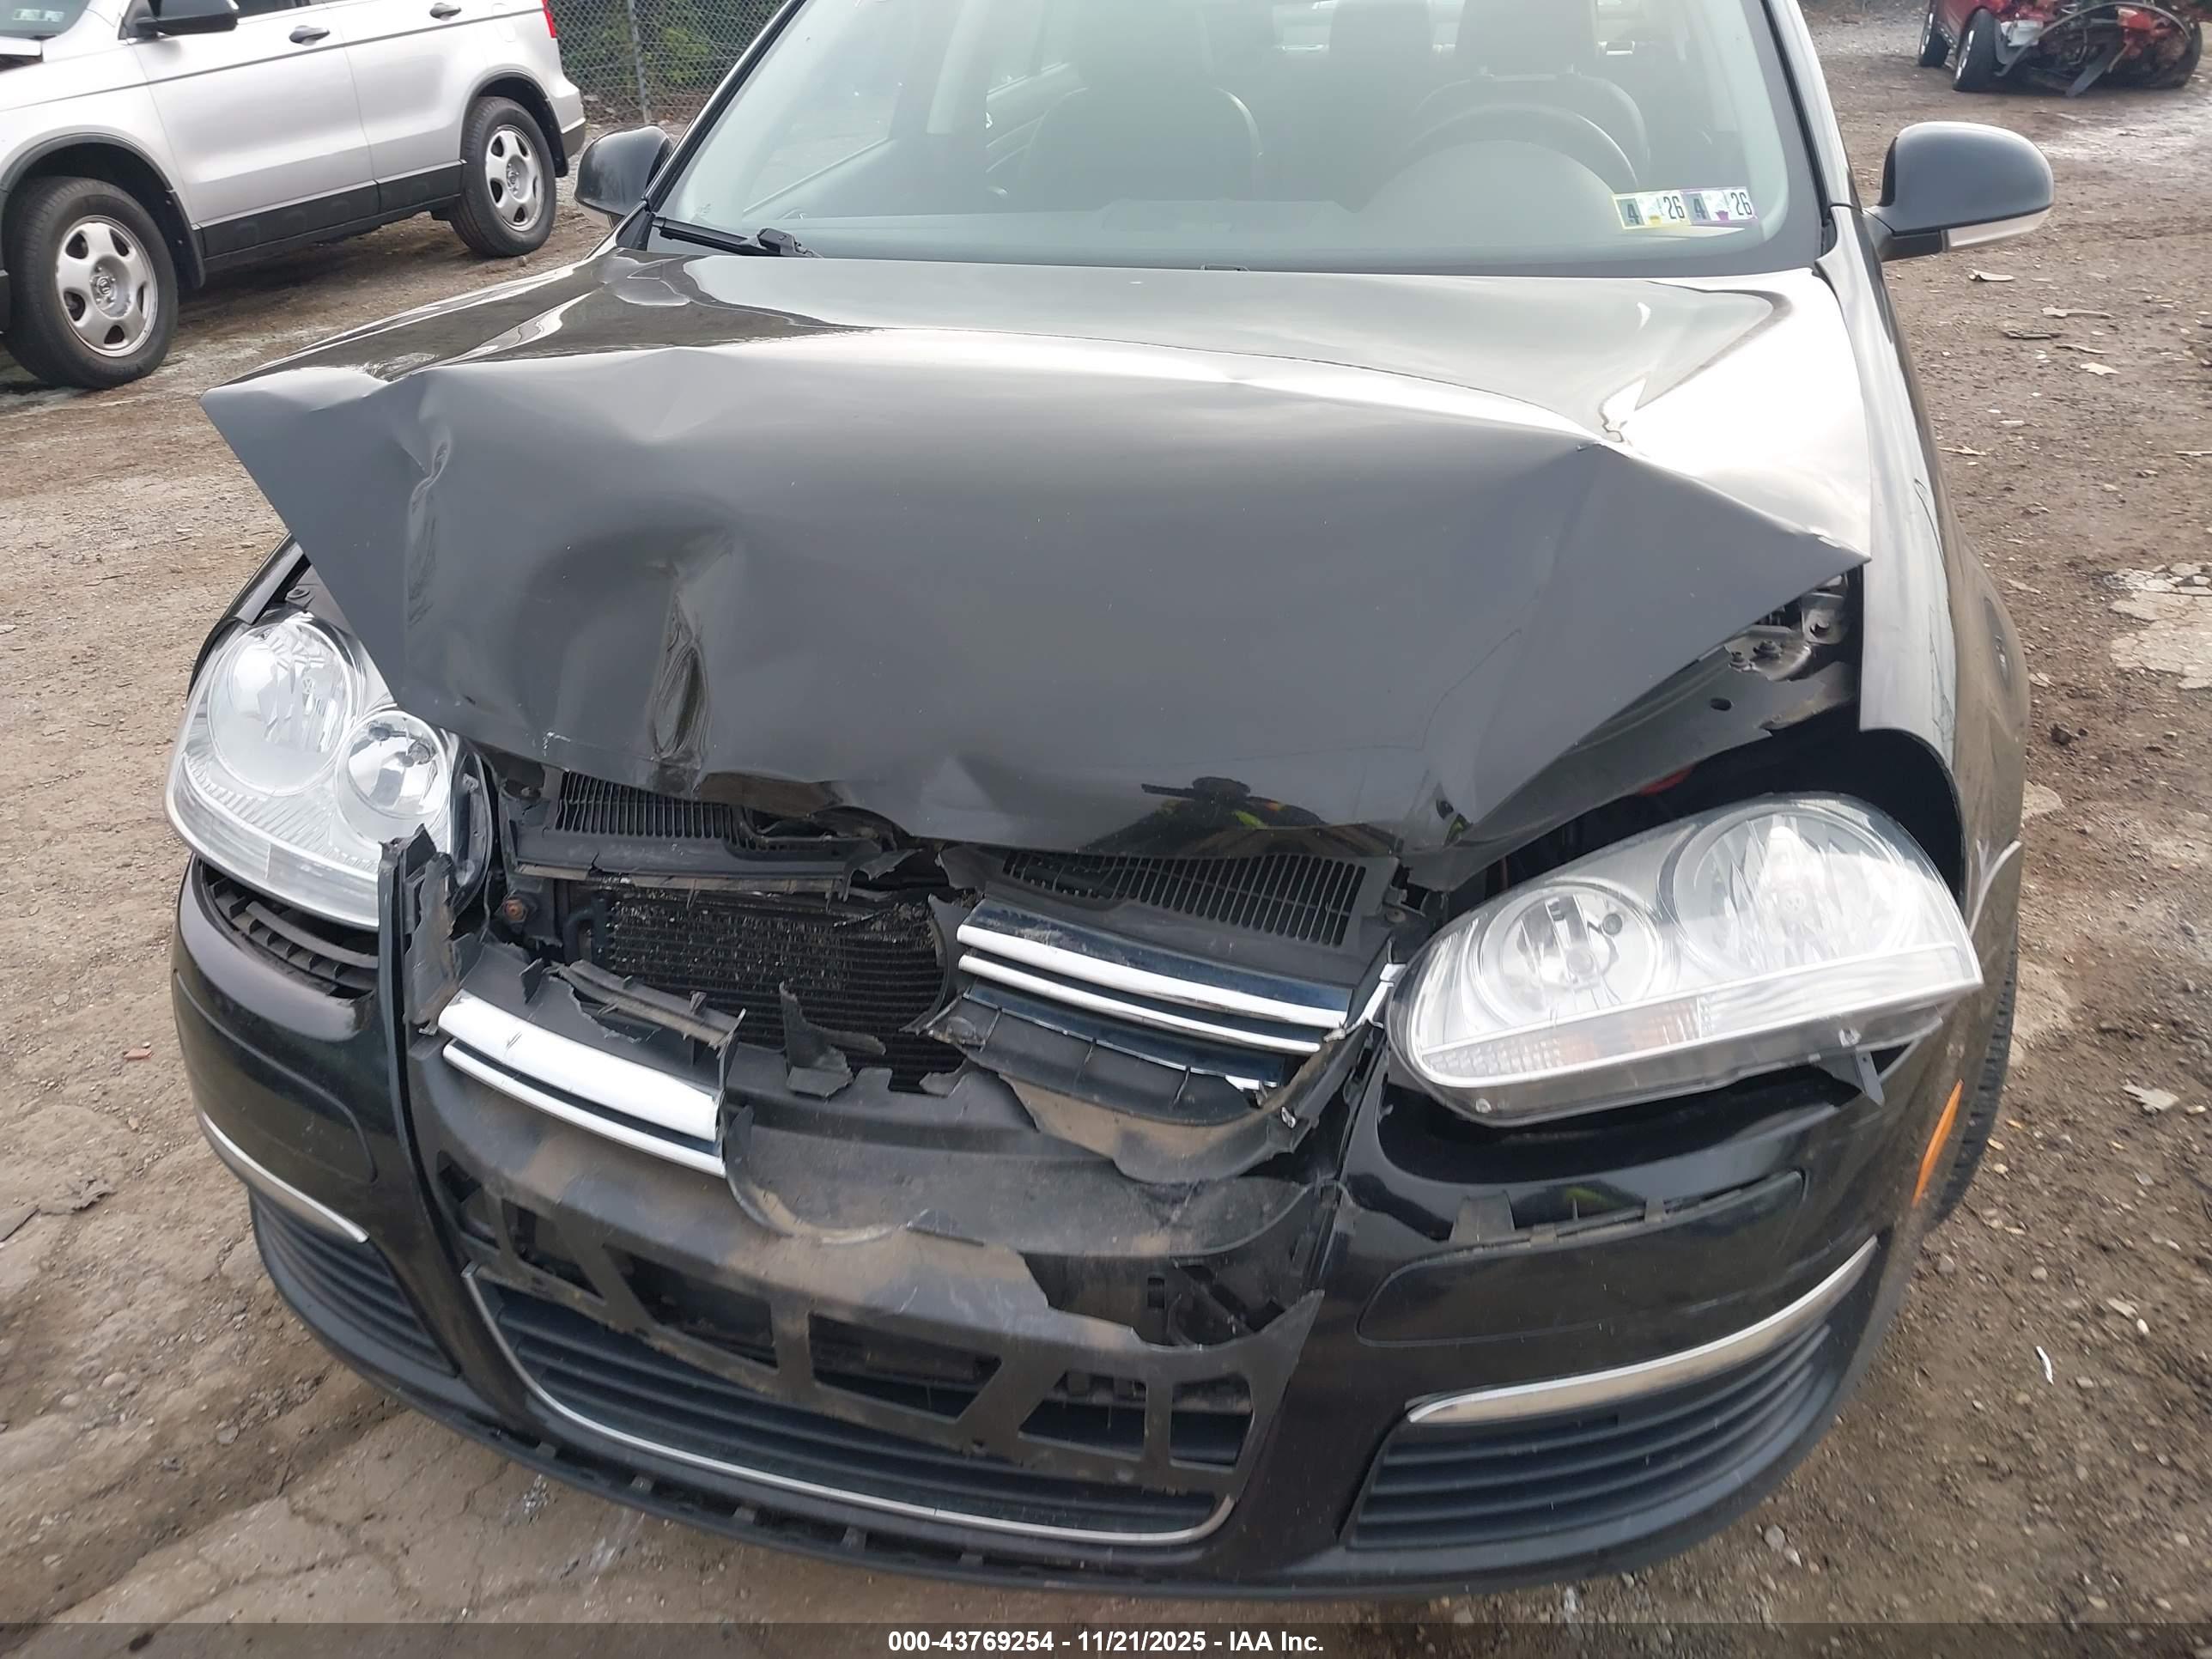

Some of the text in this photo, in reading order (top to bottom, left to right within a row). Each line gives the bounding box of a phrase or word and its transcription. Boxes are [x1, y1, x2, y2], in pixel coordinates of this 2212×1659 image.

[1626, 204, 1640, 225] 4
[1663, 196, 1686, 220] 26
[1693, 198, 1706, 220] 4
[1731, 191, 1753, 216] 26
